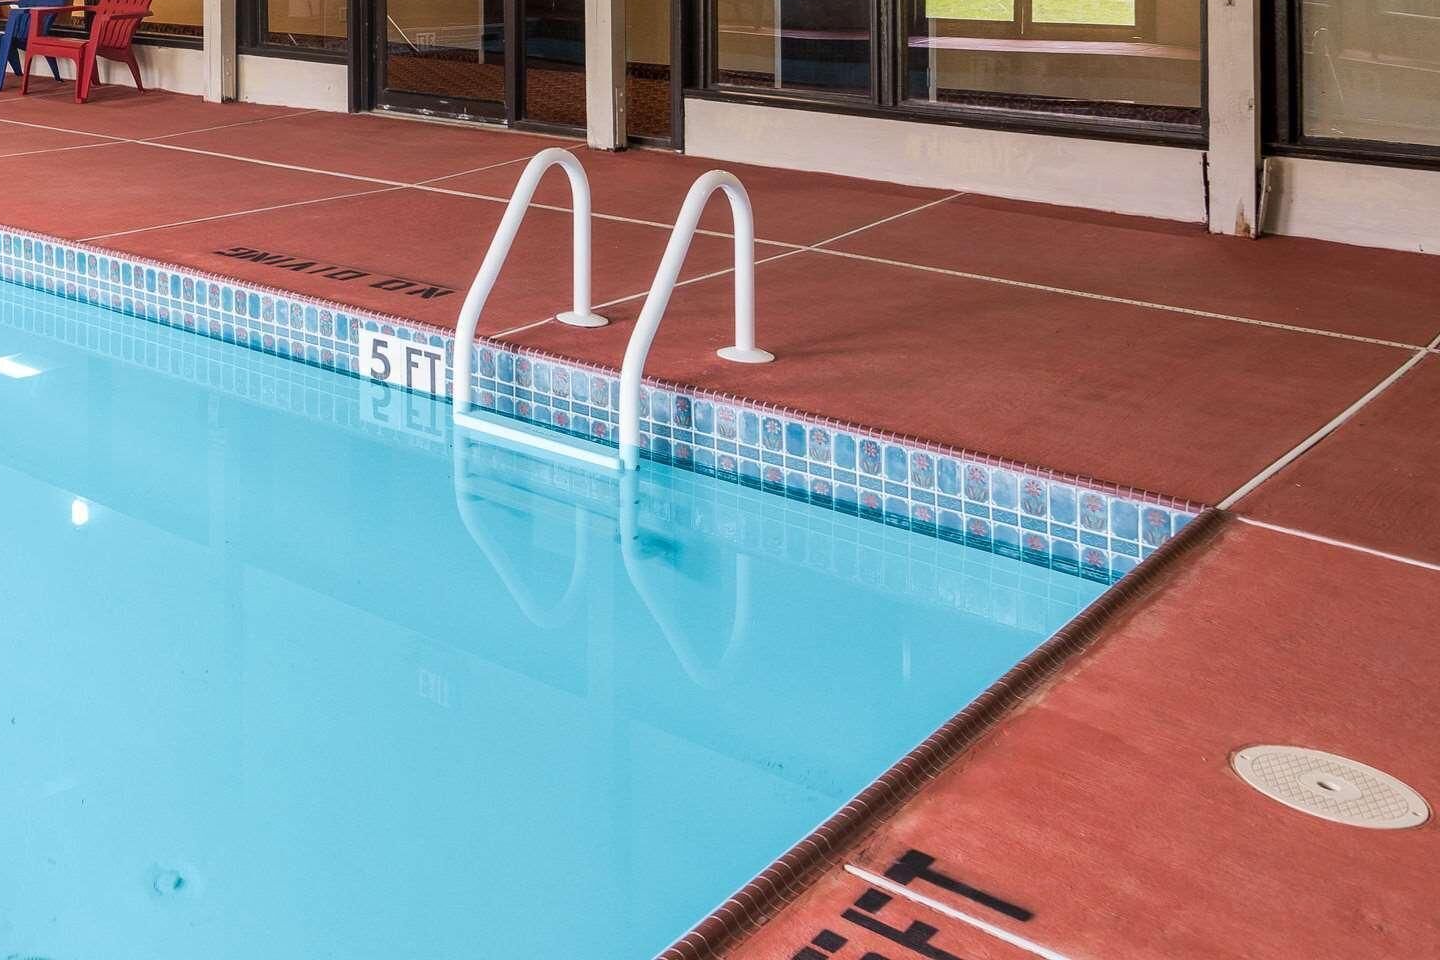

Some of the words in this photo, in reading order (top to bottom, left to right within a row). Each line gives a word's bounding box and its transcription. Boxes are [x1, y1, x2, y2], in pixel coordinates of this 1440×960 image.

[213, 247, 371, 281] DIVING
[369, 279, 456, 299] NO
[370, 338, 392, 381] 5
[405, 346, 441, 401] FT
